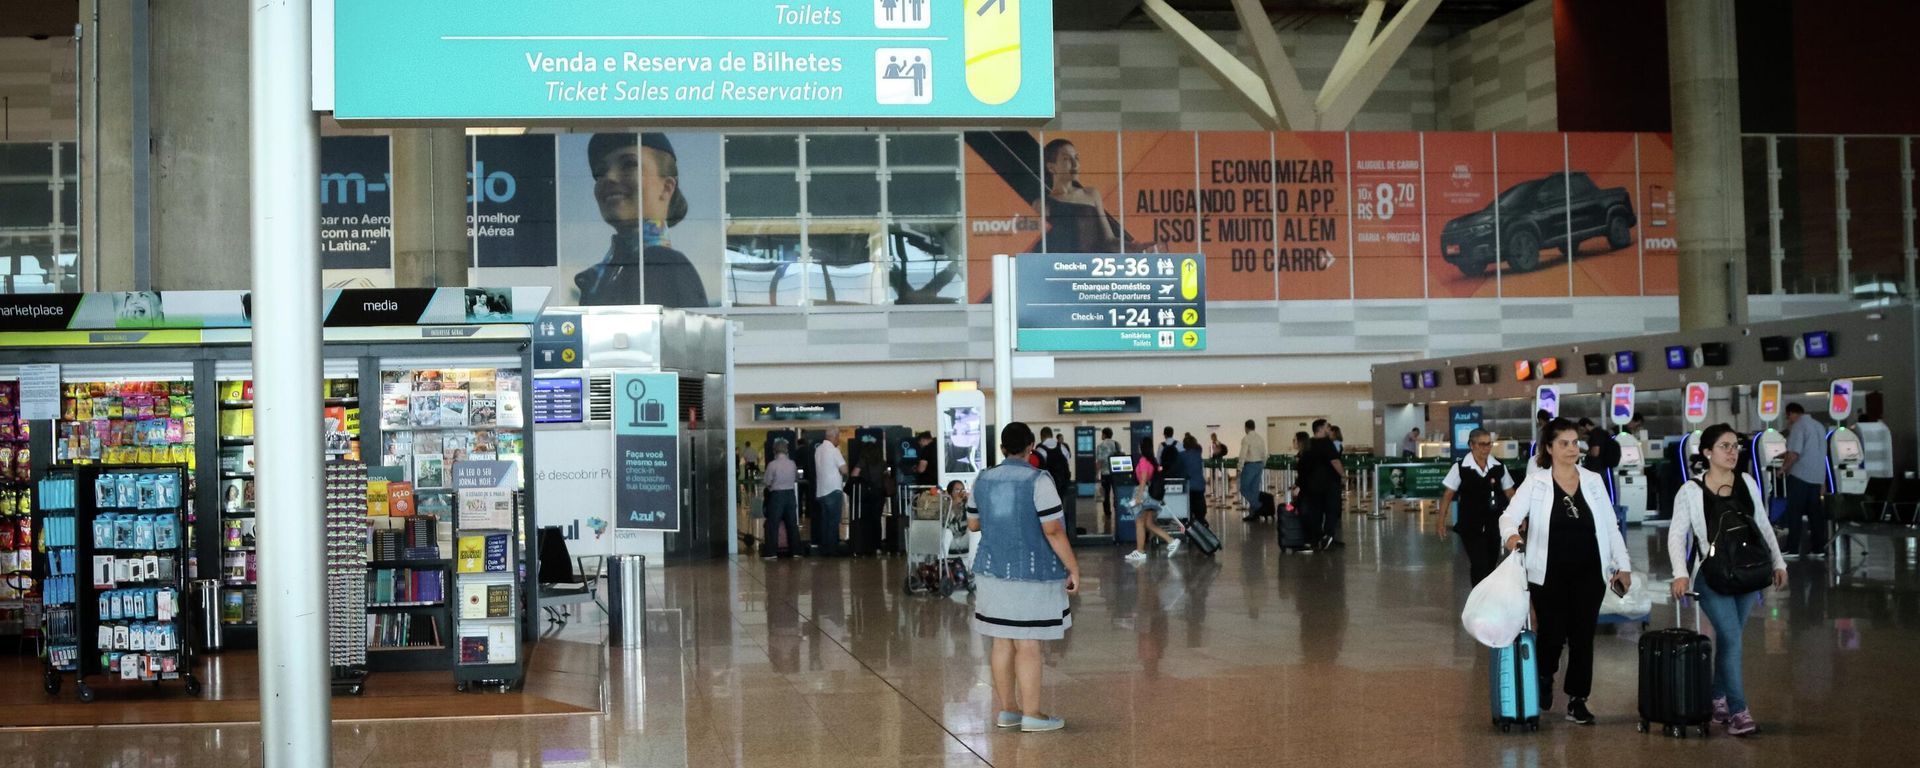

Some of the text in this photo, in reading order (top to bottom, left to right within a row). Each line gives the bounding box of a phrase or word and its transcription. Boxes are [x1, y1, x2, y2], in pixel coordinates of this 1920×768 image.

[775, 4, 842, 25] Toilets
[525, 50, 842, 72] Venda e Reserva de Bilhetes
[545, 80, 843, 102] Ticket Sales and Reservation
[1211, 160, 1334, 183] ECONOMIZAR
[1136, 189, 1236, 213] ALUGANDO
[1243, 189, 1289, 213] PELO
[1358, 203, 1374, 220] R$
[343, 217, 358, 225] no
[478, 212, 521, 224] melhor
[321, 229, 348, 238] com
[351, 230, 359, 238] a
[478, 224, 515, 236] Aérea
[1153, 213, 1336, 243] ISSO É MUITO ALÉM
[1231, 247, 1327, 272] DO CARRO
[1054, 257, 1150, 277] Check-in 25-36
[1072, 280, 1151, 293] Embarque Doméstico
[1078, 292, 1151, 301] Domestic Departures
[363, 299, 398, 311] media
[1071, 308, 1151, 327] Check-in 1-24
[1120, 331, 1152, 340] Sanitários
[625, 450, 664, 460] Faça você
[548, 469, 599, 480] descobrir
[631, 475, 665, 484] despache
[392, 490, 410, 499] AÇÃO
[630, 511, 654, 521] Azul
